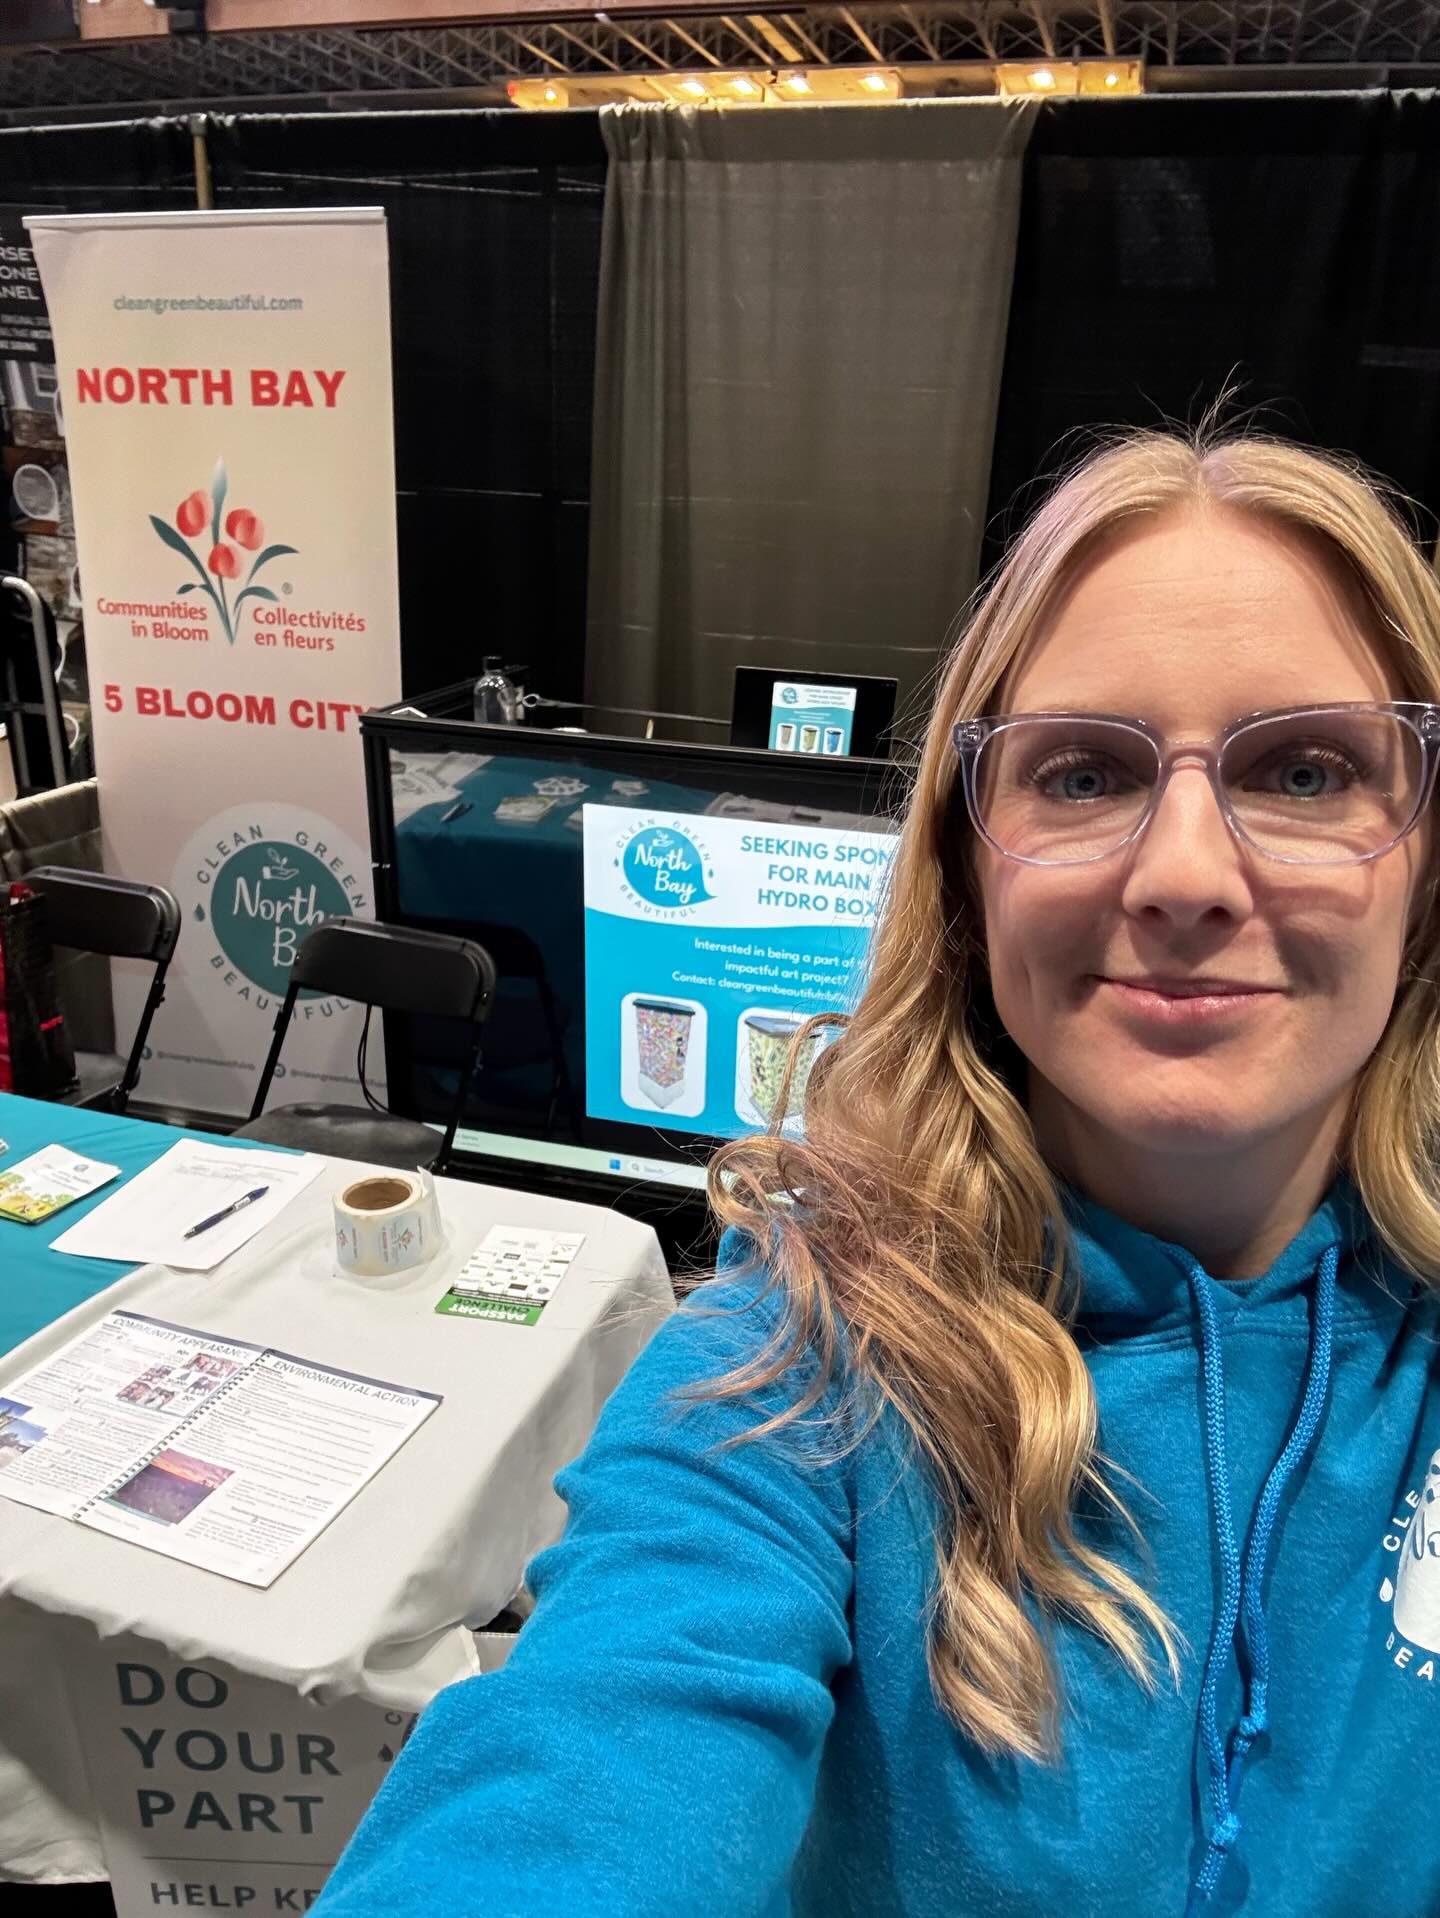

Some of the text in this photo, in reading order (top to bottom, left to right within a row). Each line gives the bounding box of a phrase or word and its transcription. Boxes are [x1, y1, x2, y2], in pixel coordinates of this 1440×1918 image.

[0, 285, 40, 300] NEL
[113, 294, 304, 315] cleangreenbeautiful.com
[77, 367, 346, 407] NORTH BAY
[97, 598, 208, 621] Communities
[253, 607, 366, 632] Collectivités
[132, 621, 208, 641] in Bloom
[254, 630, 335, 651] en fleurs
[104, 685, 123, 712] 5
[136, 689, 276, 726] BLOOM
[634, 843, 692, 871] North
[741, 835, 829, 860] SEEKING
[196, 824, 366, 908] CLEAN GREEN
[768, 864, 870, 890] FOR MAIN
[654, 870, 697, 904] Bay
[758, 888, 828, 912] HYDRO
[232, 876, 326, 926] North
[694, 938, 751, 956] Interested
[754, 945, 765, 957] in
[767, 946, 800, 964] being
[802, 954, 811, 963] a
[813, 953, 838, 968] part
[672, 970, 716, 987] Contact:
[725, 960, 779, 977] impactful
[781, 968, 799, 980] art
[448, 1303, 527, 1321] PASSPORT
[273, 1361, 420, 1407] ENVIRONMENTAL ACTION
[116, 1662, 228, 1709] DO
[120, 1726, 342, 1777] YOUR
[137, 1789, 324, 1834] PART
[151, 1882, 256, 1909] HELP
